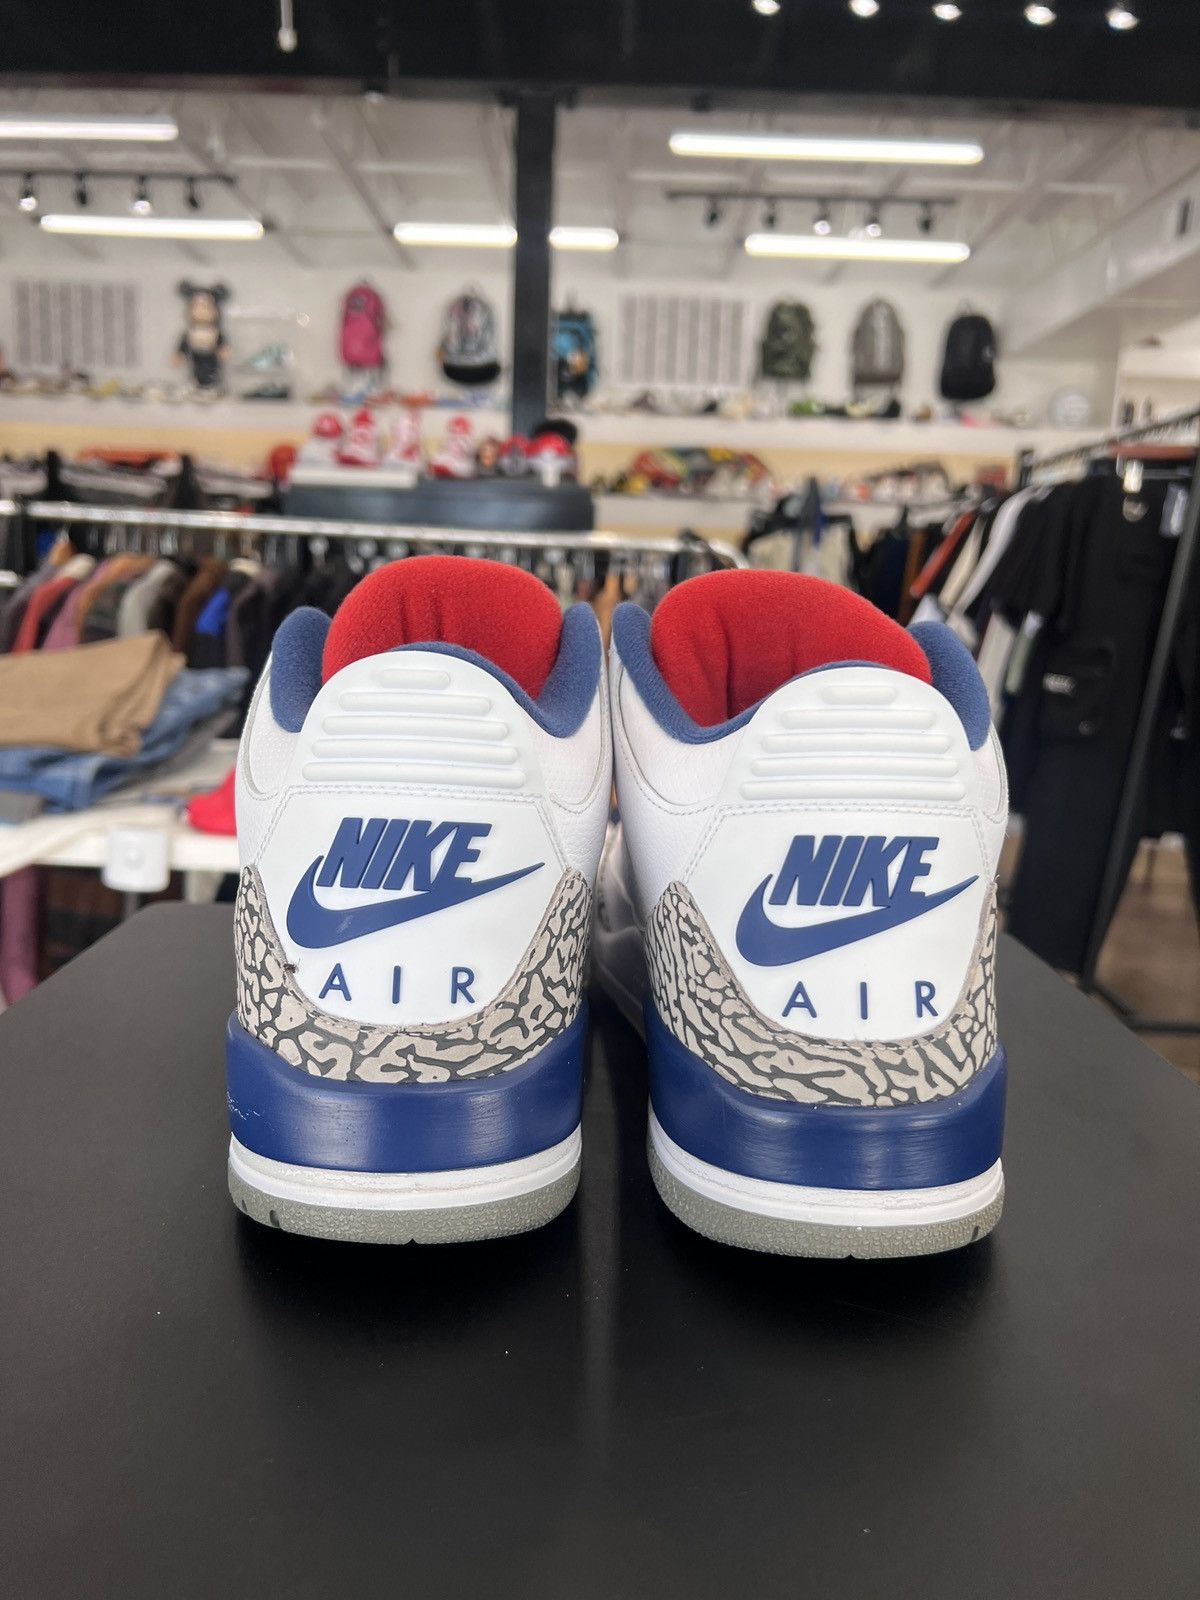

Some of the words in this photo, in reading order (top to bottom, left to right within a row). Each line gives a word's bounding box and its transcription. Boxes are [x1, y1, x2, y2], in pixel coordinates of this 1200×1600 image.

[316, 817, 492, 892] NIKE
[768, 835, 940, 907] NIKE
[318, 963, 475, 1004] AIR
[782, 980, 939, 1019] AIR
